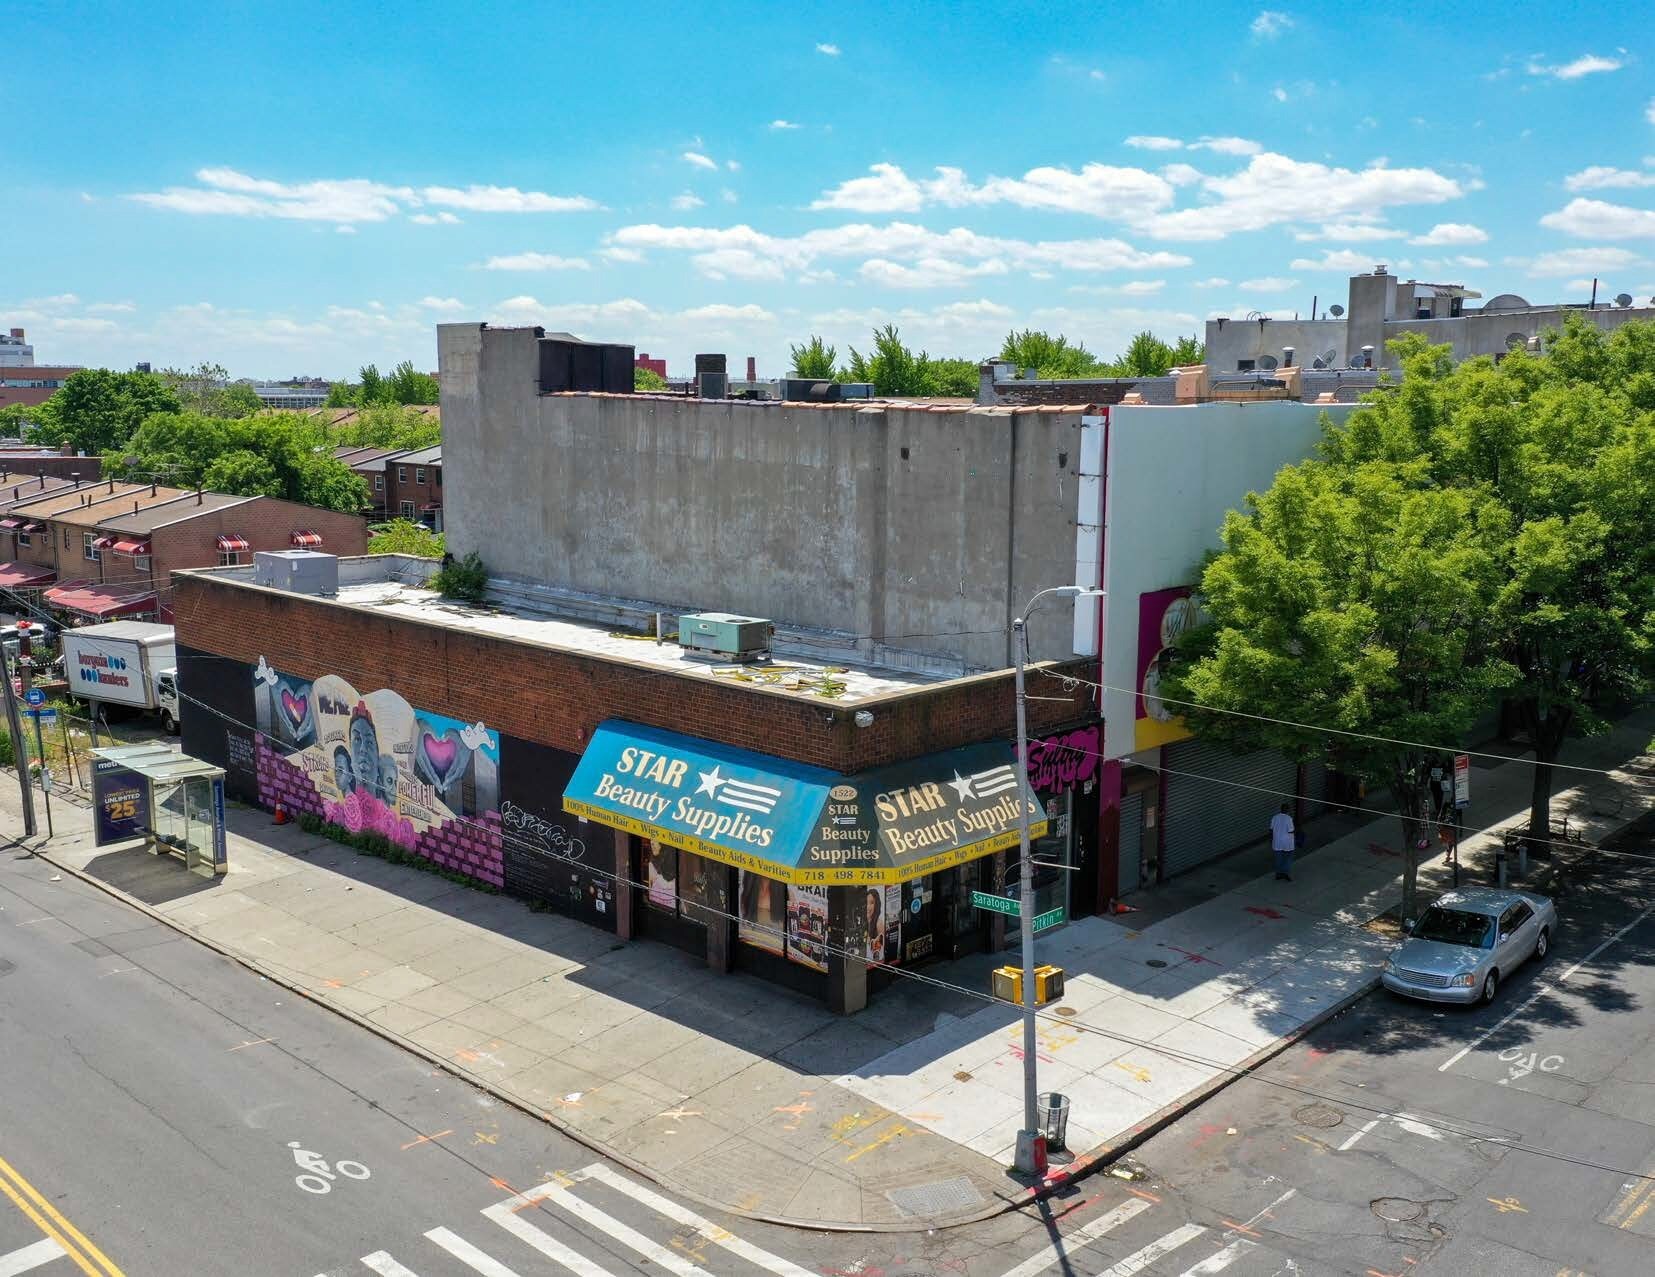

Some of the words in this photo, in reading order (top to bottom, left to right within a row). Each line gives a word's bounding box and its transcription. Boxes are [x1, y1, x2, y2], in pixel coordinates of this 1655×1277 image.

[616, 747, 688, 788] STAR
[104, 793, 140, 804] UNLIMITED
[875, 781, 947, 822] STAR
[104, 800, 137, 820] $25
[594, 773, 671, 821] Beauty
[672, 797, 775, 847] Supplies
[828, 804, 859, 815] STAR
[566, 800, 584, 814] 100%
[586, 806, 612, 824] Human
[613, 813, 628, 829] Hair
[640, 823, 660, 841] Wigs
[668, 832, 684, 845] Nail
[698, 841, 726, 860] Beauty
[728, 850, 747, 865] Aids
[748, 858, 756, 867] &
[759, 861, 791, 879] Varities
[822, 827, 871, 842] Beauty
[886, 816, 958, 854] Beauty
[810, 846, 879, 864] Supplies
[804, 871, 825, 880] 718
[833, 871, 854, 880] 498
[861, 871, 885, 880] 7841
[973, 893, 1010, 912] Saratoga
[1032, 914, 1054, 931] Pitkin
